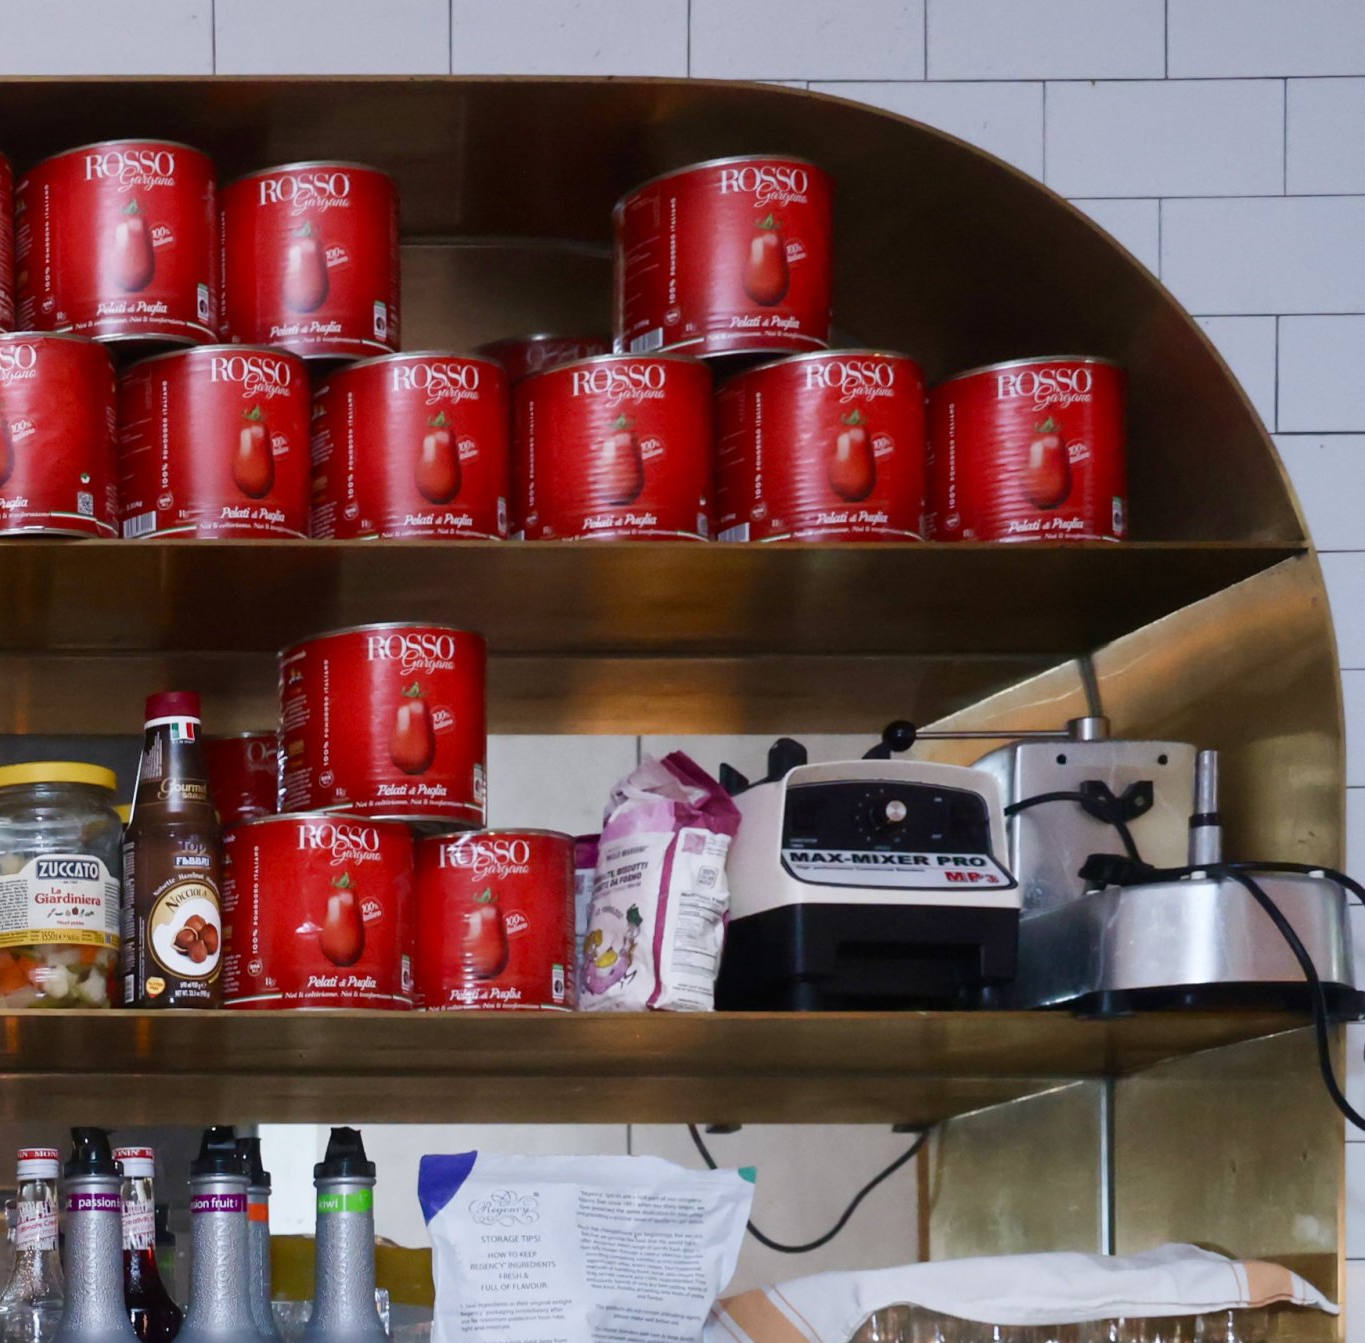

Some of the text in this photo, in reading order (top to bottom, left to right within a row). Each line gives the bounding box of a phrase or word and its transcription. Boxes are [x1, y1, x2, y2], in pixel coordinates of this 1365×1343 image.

[85, 152, 175, 181] ROSSO
[259, 173, 350, 205] ROSSO
[721, 167, 808, 196] ROSSO
[393, 364, 479, 392] ROSSO
[573, 368, 666, 398] ROSSO
[806, 364, 894, 391] ROSSO
[368, 635, 454, 661] ROSSO
[401, 652, 454, 675] Gargano
[377, 784, 447, 799] Pelati Puglia
[297, 824, 379, 850] ROSSO
[37, 861, 99, 878] ZUCCATO
[790, 852, 987, 867] MAX-MIXER PRO
[945, 871, 999, 884] MP3
[35, 893, 101, 906] Giardiniera
[211, 1198, 234, 1209] fruit
[522, 1235, 541, 1243] TIPS!
